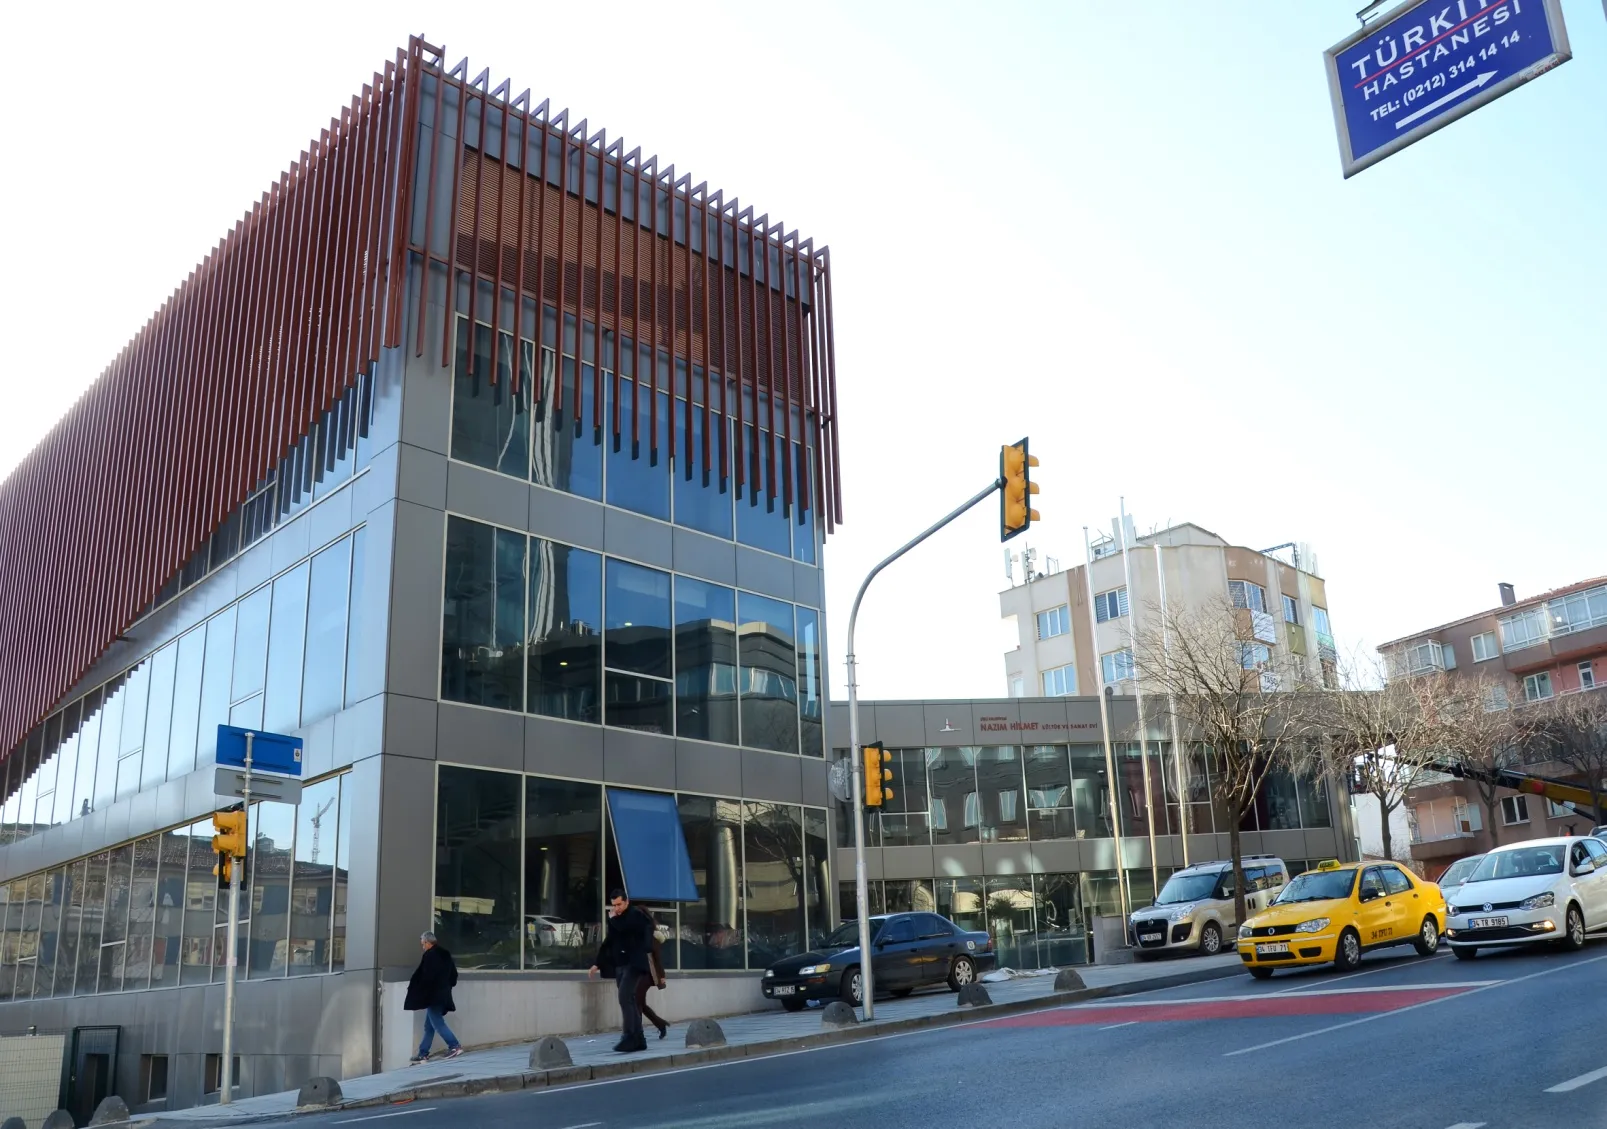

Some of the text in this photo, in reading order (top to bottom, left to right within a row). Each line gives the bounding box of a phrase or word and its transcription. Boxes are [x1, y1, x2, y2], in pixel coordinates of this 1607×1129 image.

[1370, 30, 1520, 121] TEL: (0212) 314 14 14
[980, 723, 1007, 731] NAZIM
[1472, 920, 1480, 928] 34
[1481, 919, 1489, 927] TR
